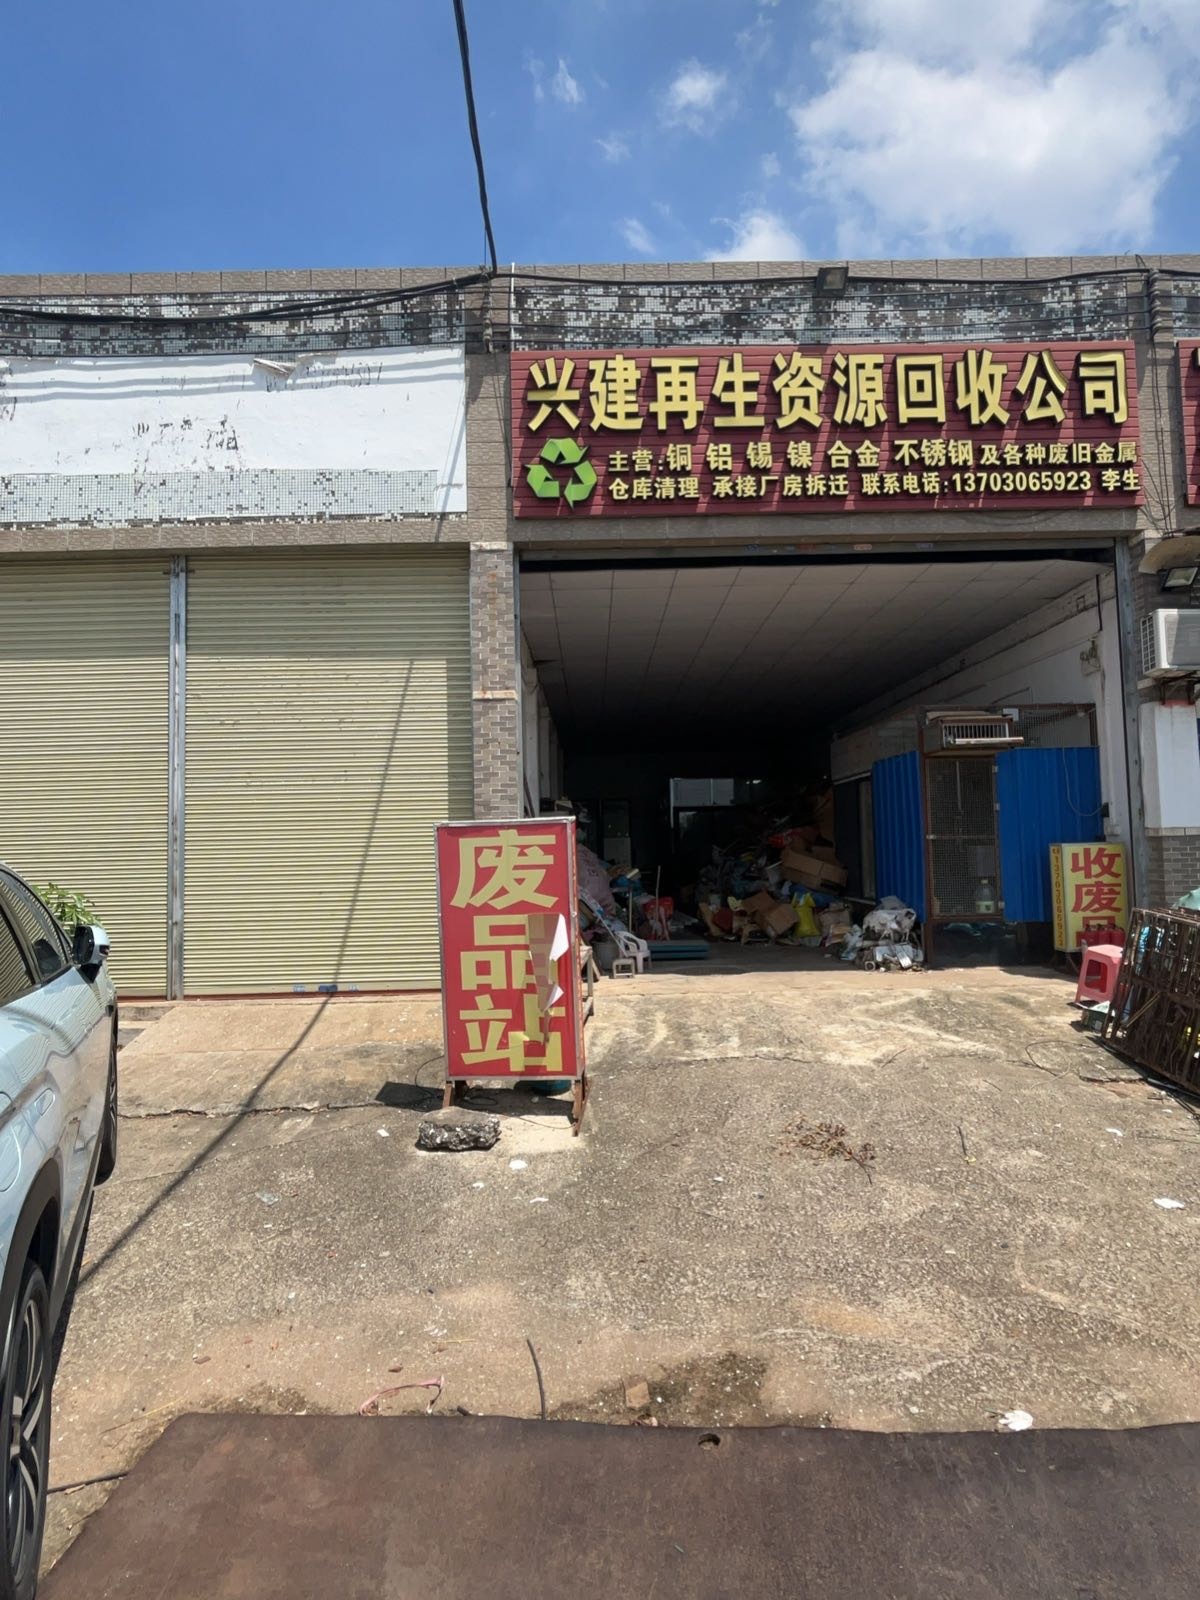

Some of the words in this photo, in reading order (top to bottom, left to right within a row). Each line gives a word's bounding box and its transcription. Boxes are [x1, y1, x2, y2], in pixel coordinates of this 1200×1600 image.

[527, 349, 1129, 432] 兴建再生资源回收公司
[608, 476, 700, 500] 仓库清理
[713, 474, 849, 497] 承接厂房拆迁
[1101, 468, 1141, 491] 李生
[450, 829, 566, 1072] 废品站
